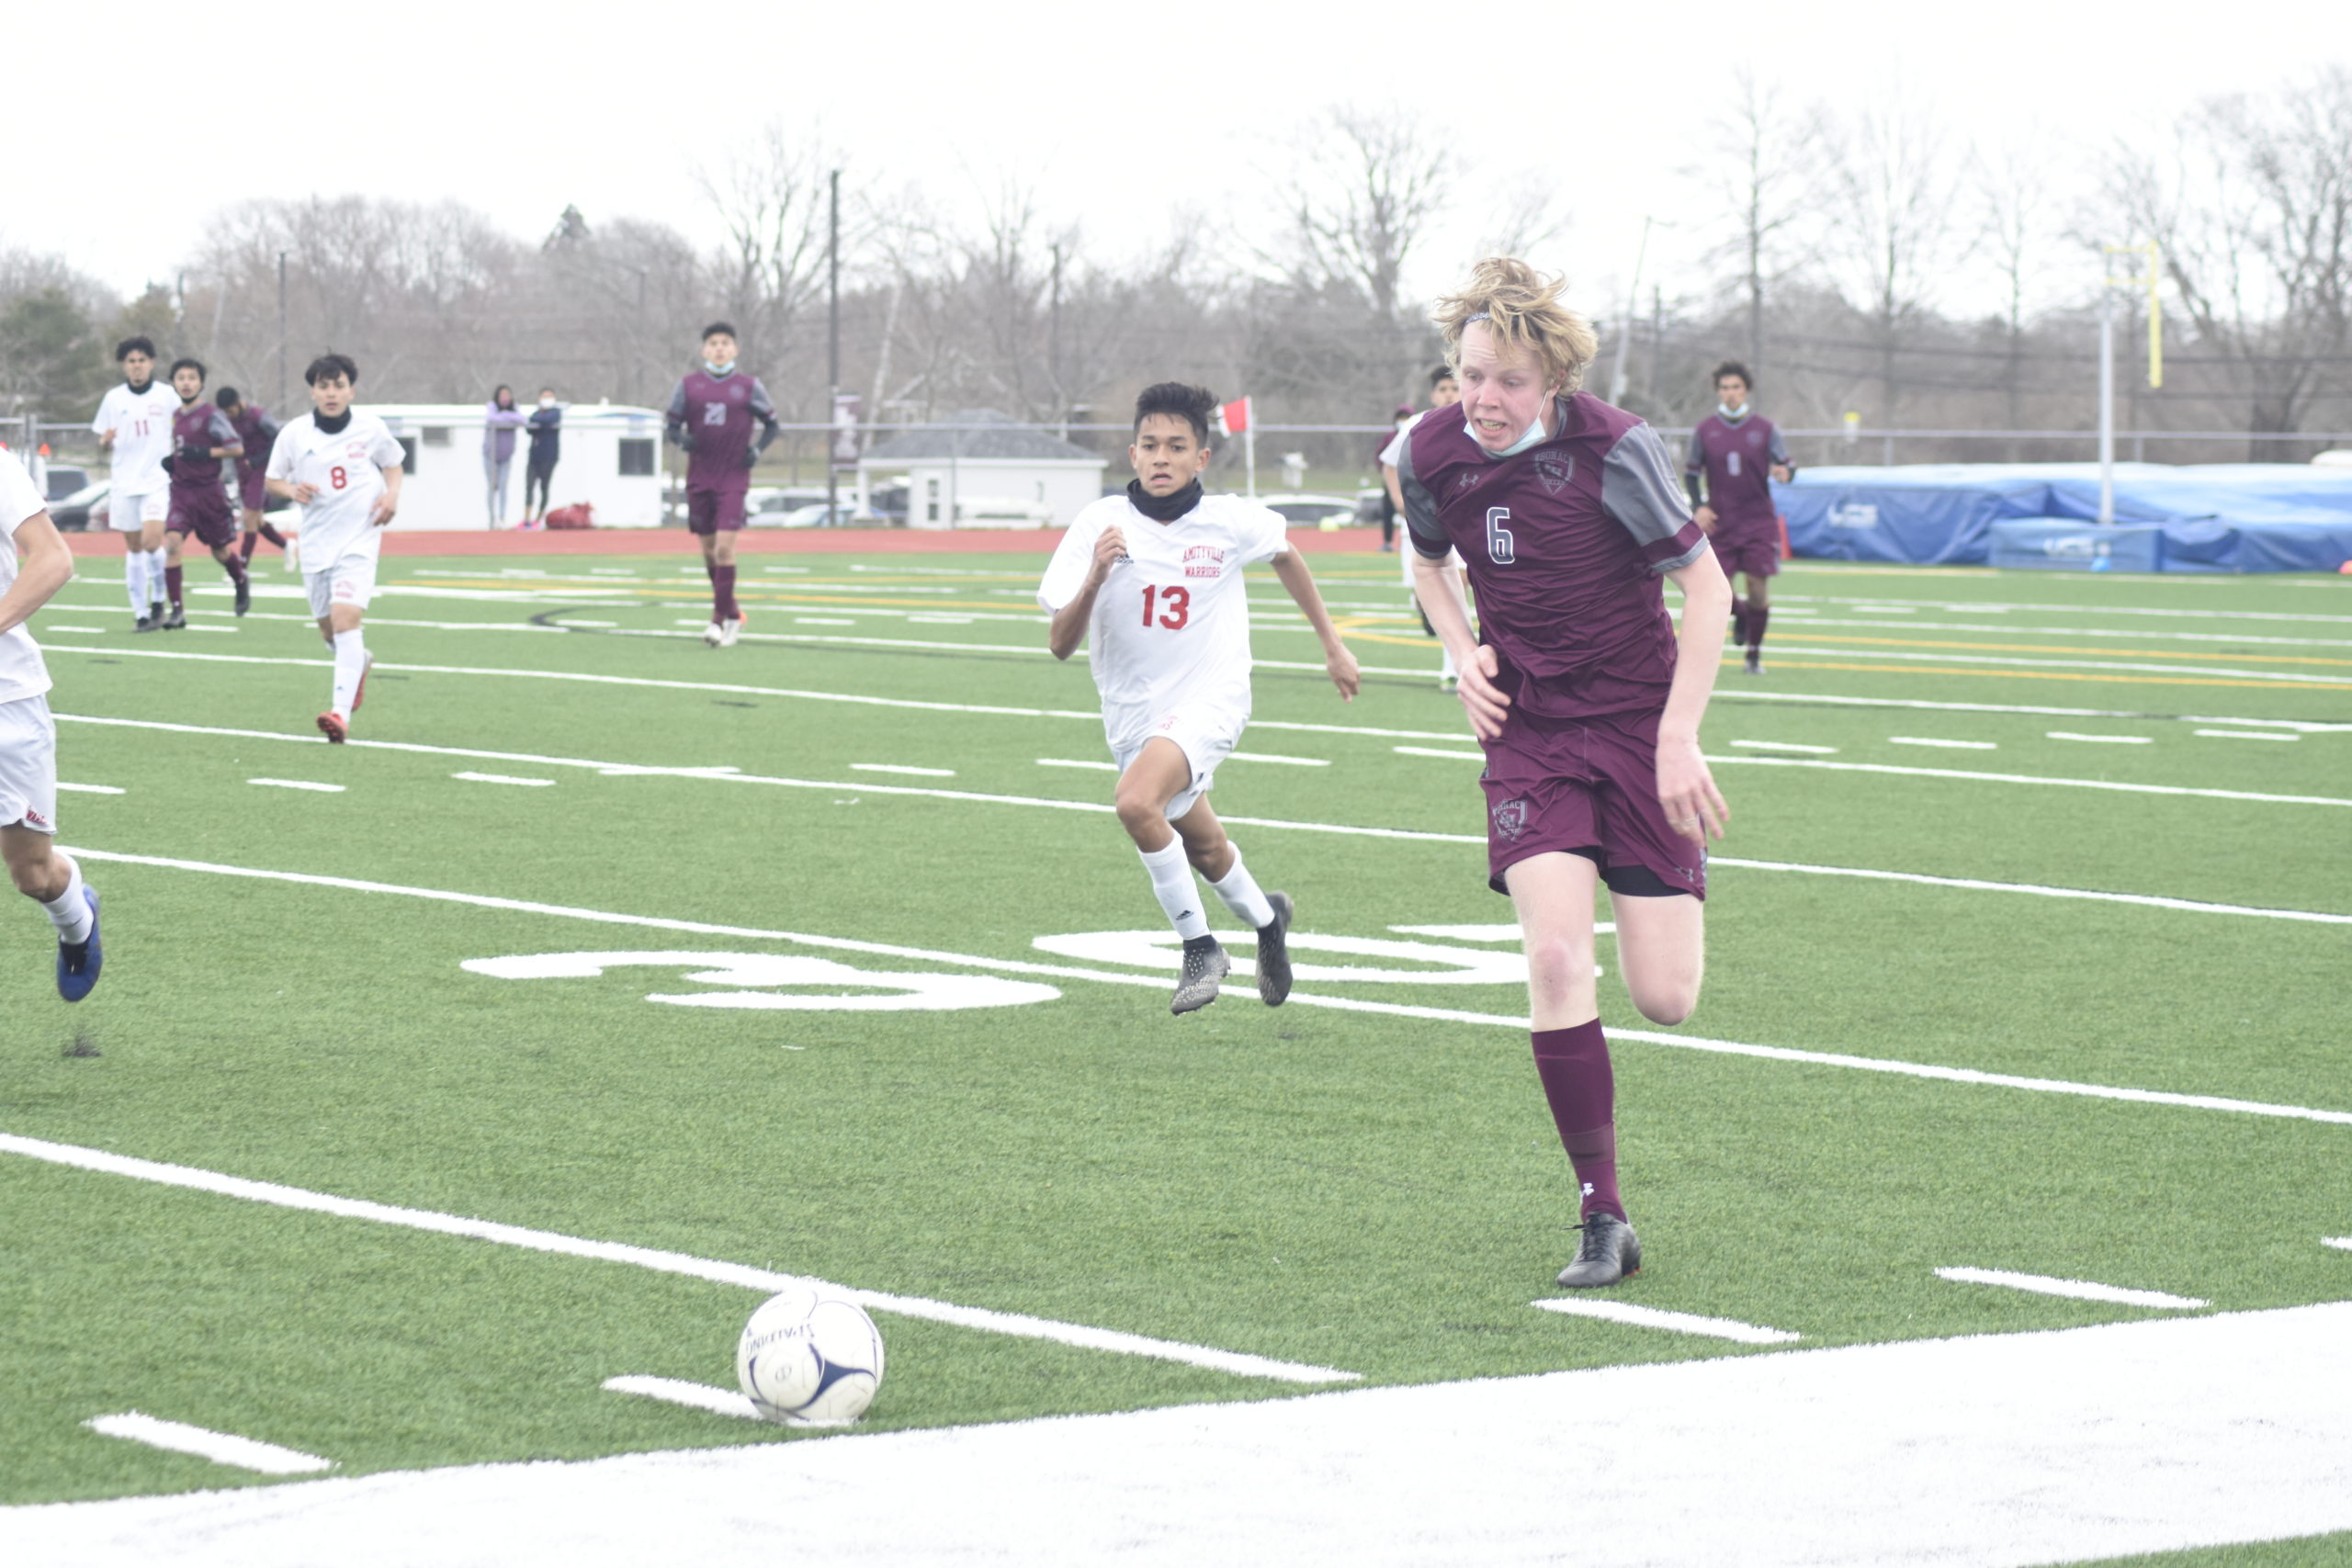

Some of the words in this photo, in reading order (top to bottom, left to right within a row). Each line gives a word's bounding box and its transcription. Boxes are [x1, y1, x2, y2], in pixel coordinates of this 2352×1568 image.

[134, 420, 149, 436] 11
[331, 466, 347, 490] 8
[1487, 506, 1516, 565] 6
[1182, 545, 1225, 563] AMITYVILLE
[1185, 566, 1221, 578] WARRIORS
[1142, 584, 1190, 630] 13
